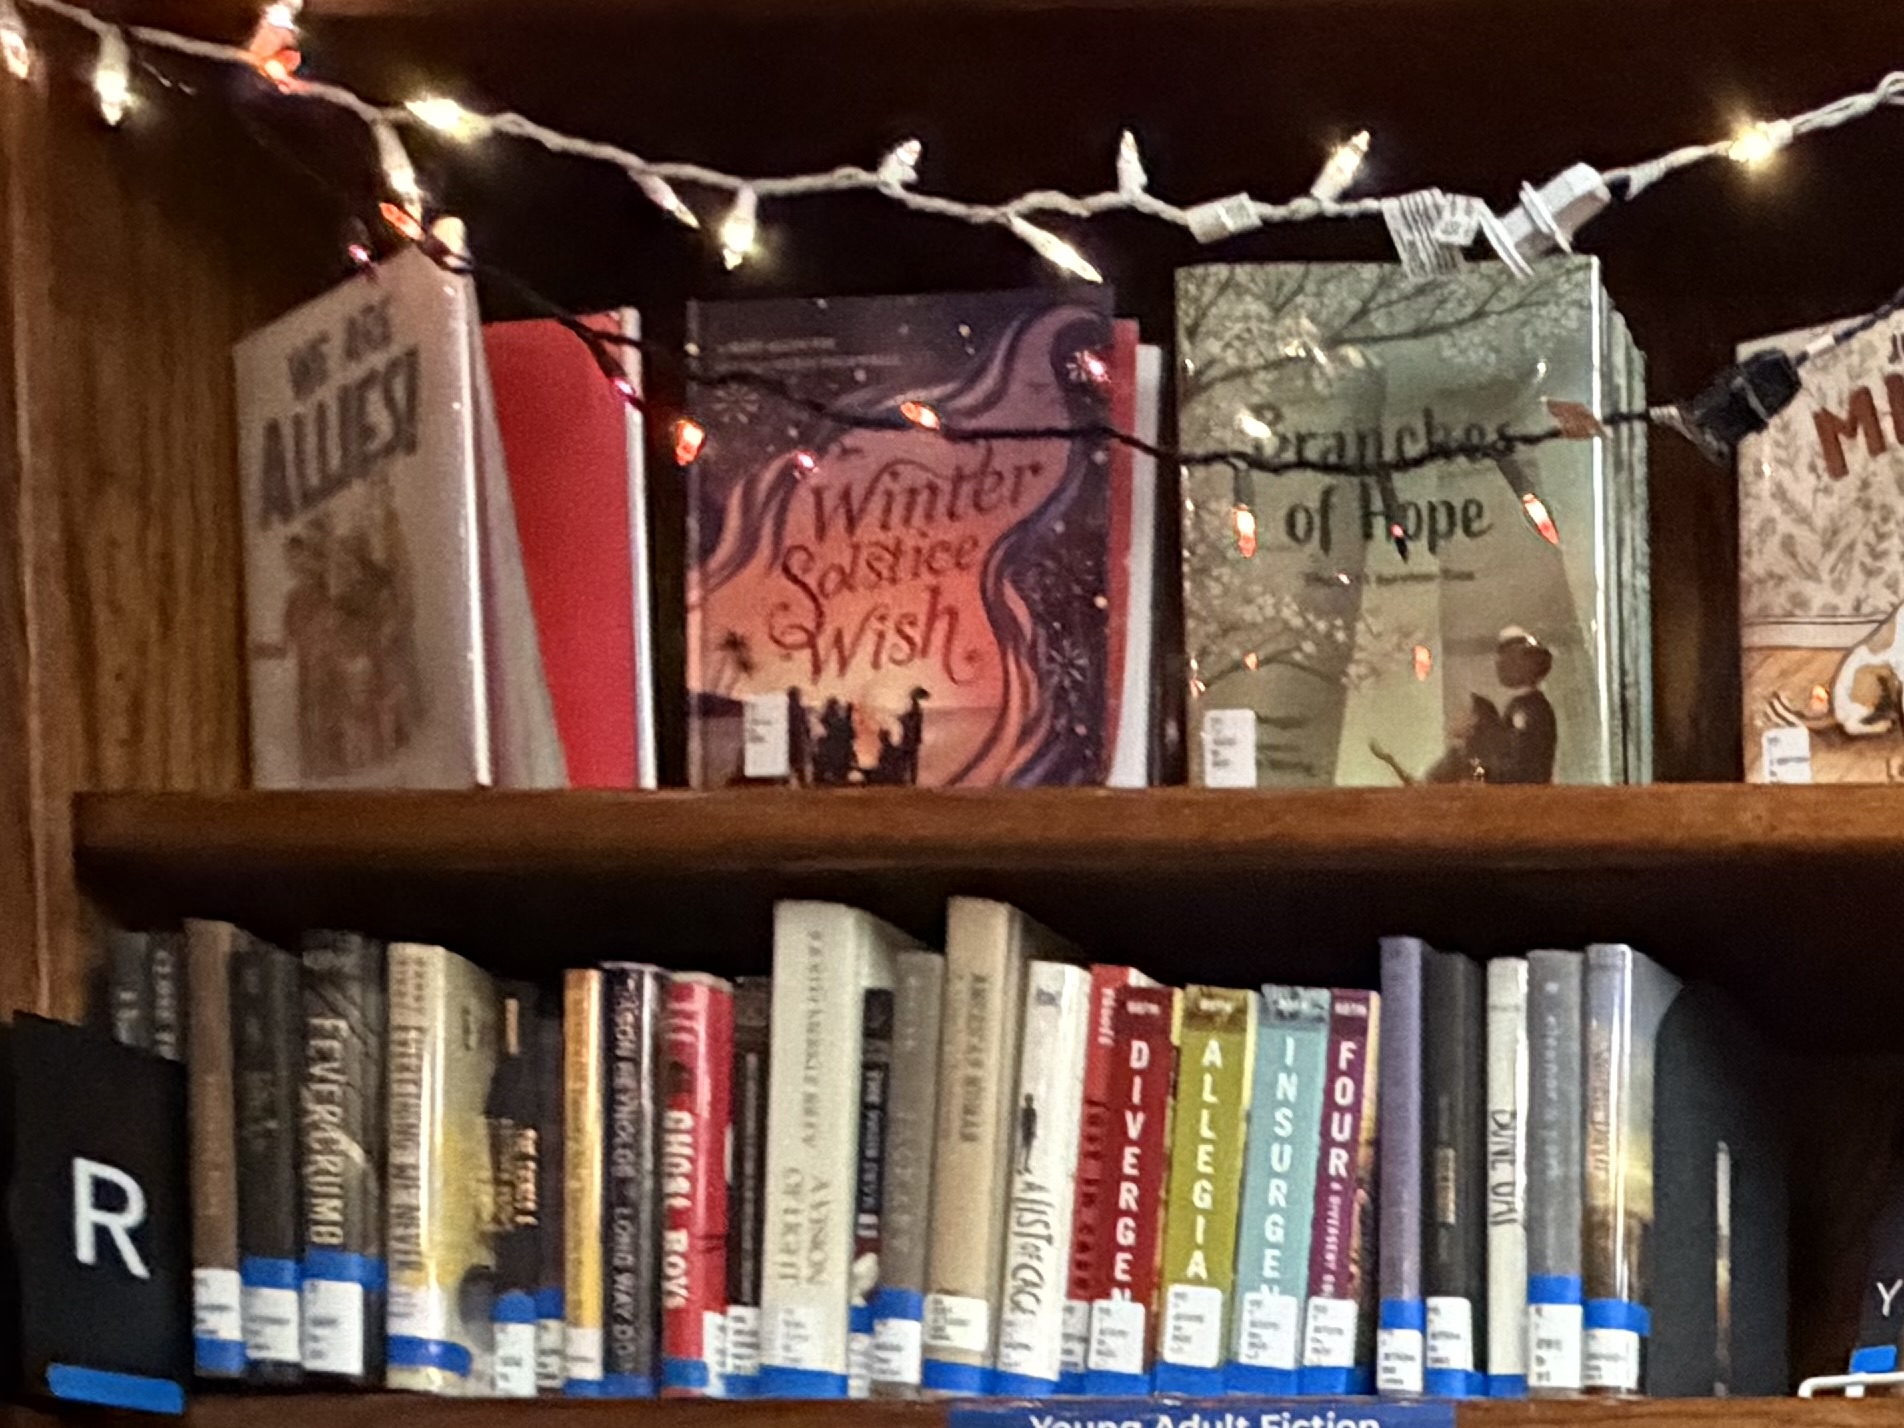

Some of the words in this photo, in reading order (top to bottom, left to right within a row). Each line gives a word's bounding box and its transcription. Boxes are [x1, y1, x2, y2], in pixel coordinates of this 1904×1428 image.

[287, 346, 329, 396] WE
[343, 301, 393, 372] ARE
[257, 344, 422, 531] ALLIES!
[810, 456, 1039, 542] Winter
[1284, 480, 1333, 552] of
[1361, 480, 1492, 559] Hope
[781, 533, 979, 623] Solstice
[770, 602, 979, 683] Wish
[1328, 1038, 1358, 1179] FOUR
[72, 1157, 150, 1279] R
